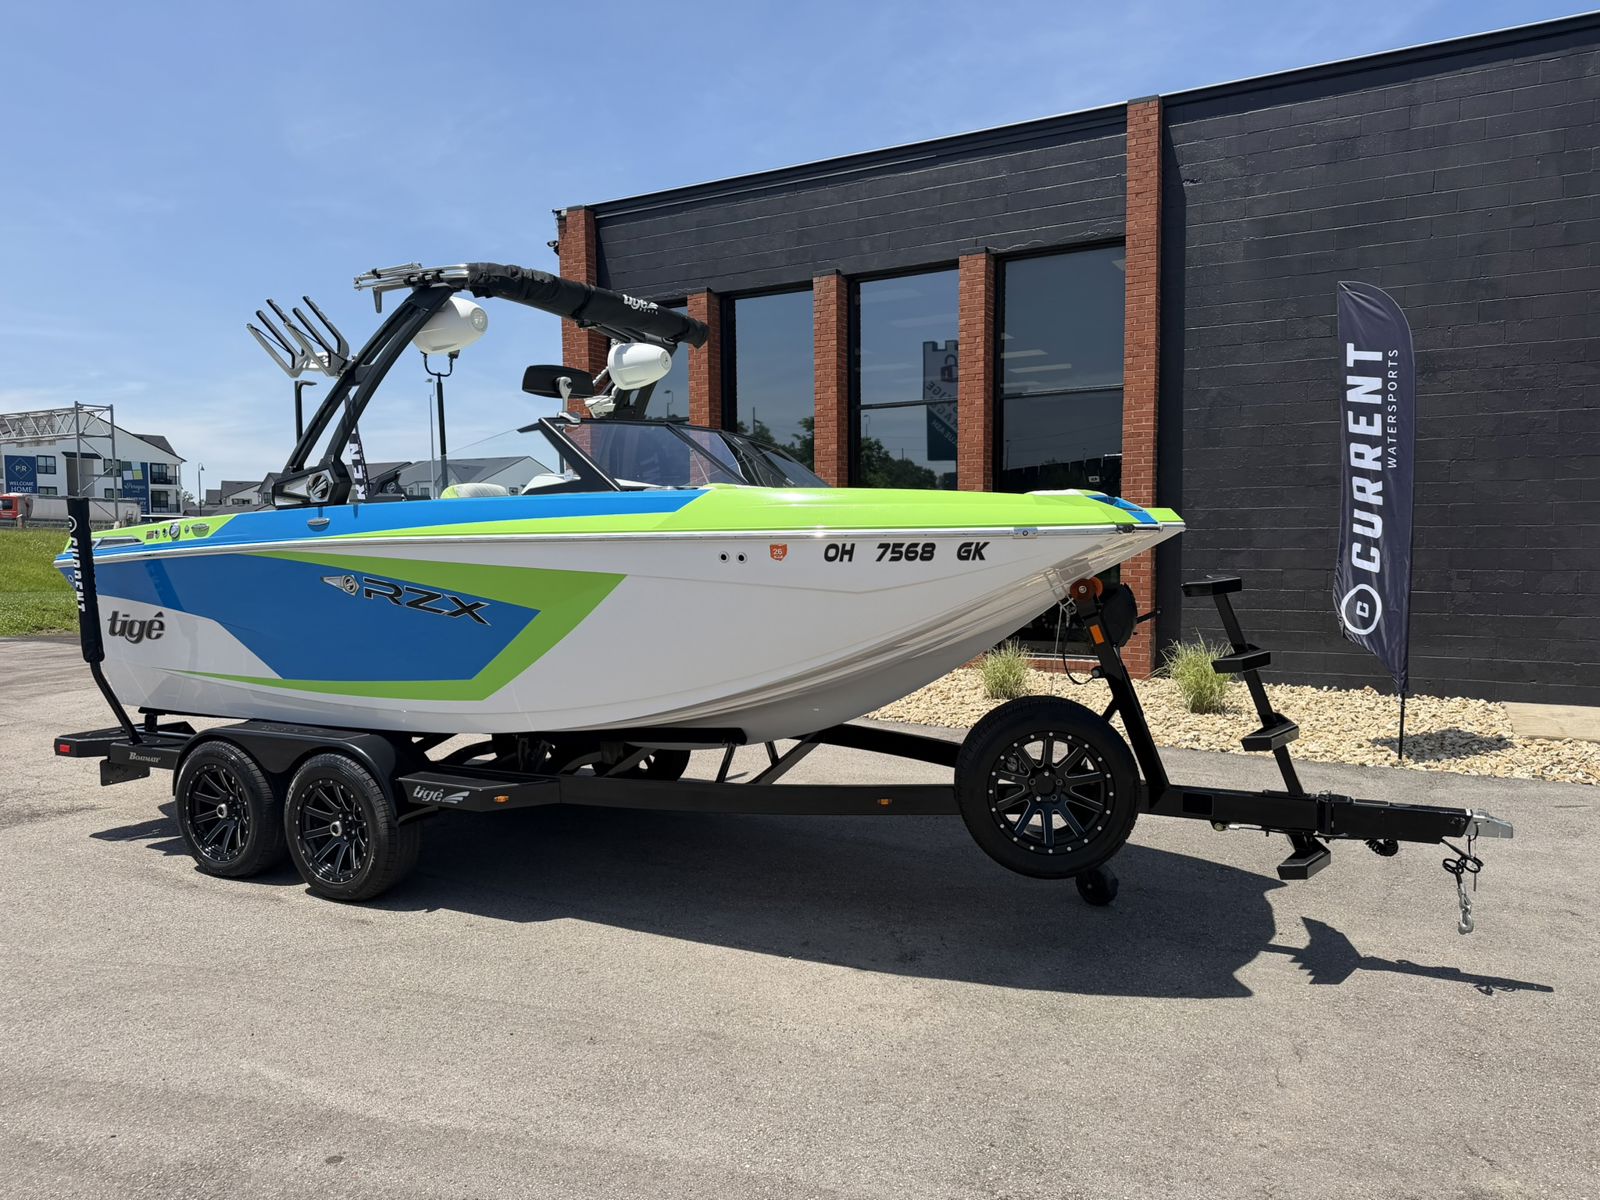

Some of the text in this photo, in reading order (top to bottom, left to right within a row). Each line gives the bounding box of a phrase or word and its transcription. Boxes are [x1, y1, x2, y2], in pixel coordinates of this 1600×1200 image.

[1387, 349, 1399, 469] WATERSPORTS
[1346, 343, 1384, 573] CURRENT
[824, 541, 990, 562] OH 7568 GK
[363, 576, 492, 626] RZX
